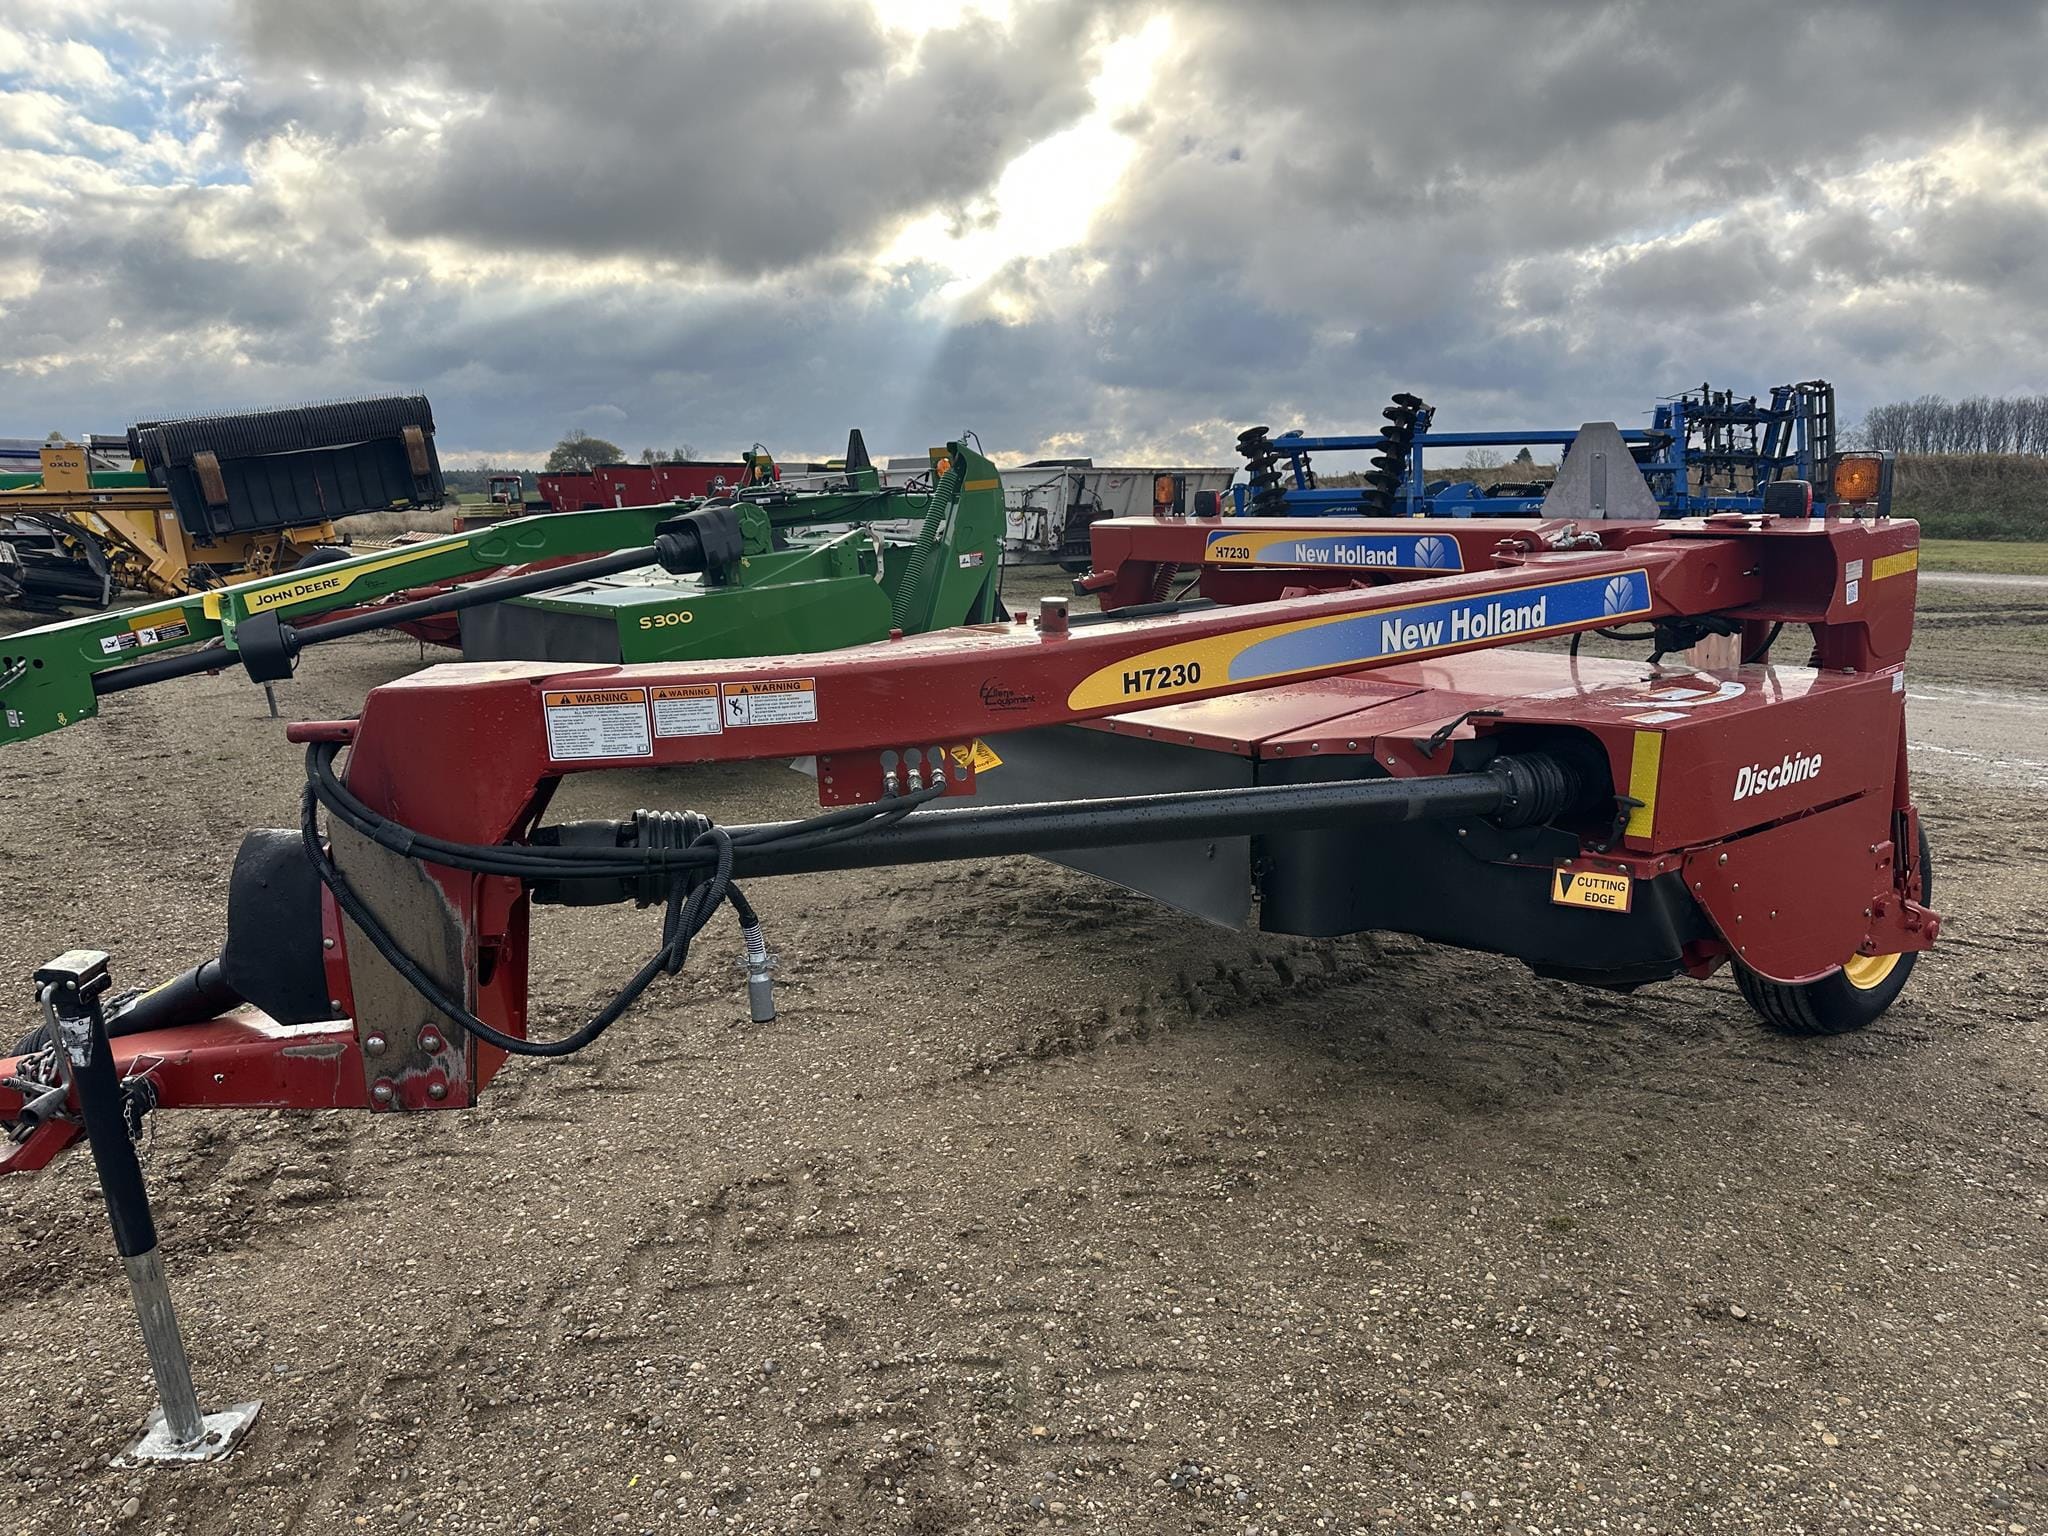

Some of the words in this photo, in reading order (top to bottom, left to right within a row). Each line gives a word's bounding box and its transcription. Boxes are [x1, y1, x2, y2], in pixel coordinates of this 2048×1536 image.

[49, 460, 79, 468] oxbo
[1215, 546, 1250, 560] H7230
[1295, 543, 1329, 562] New
[1334, 545, 1397, 566] Holland
[256, 589, 293, 607] JOHN
[294, 578, 341, 597] DEERE
[639, 610, 694, 630] S300
[1380, 617, 1443, 654] New
[1450, 595, 1546, 642] Holland
[1122, 661, 1201, 695] H7230
[668, 688, 710, 697] WARNING
[751, 682, 800, 692] WARNING
[575, 692, 629, 704] WARNING
[1733, 751, 1823, 801] Discbine
[1577, 876, 1626, 892] CUTTING
[1584, 891, 1616, 905] EDGE
